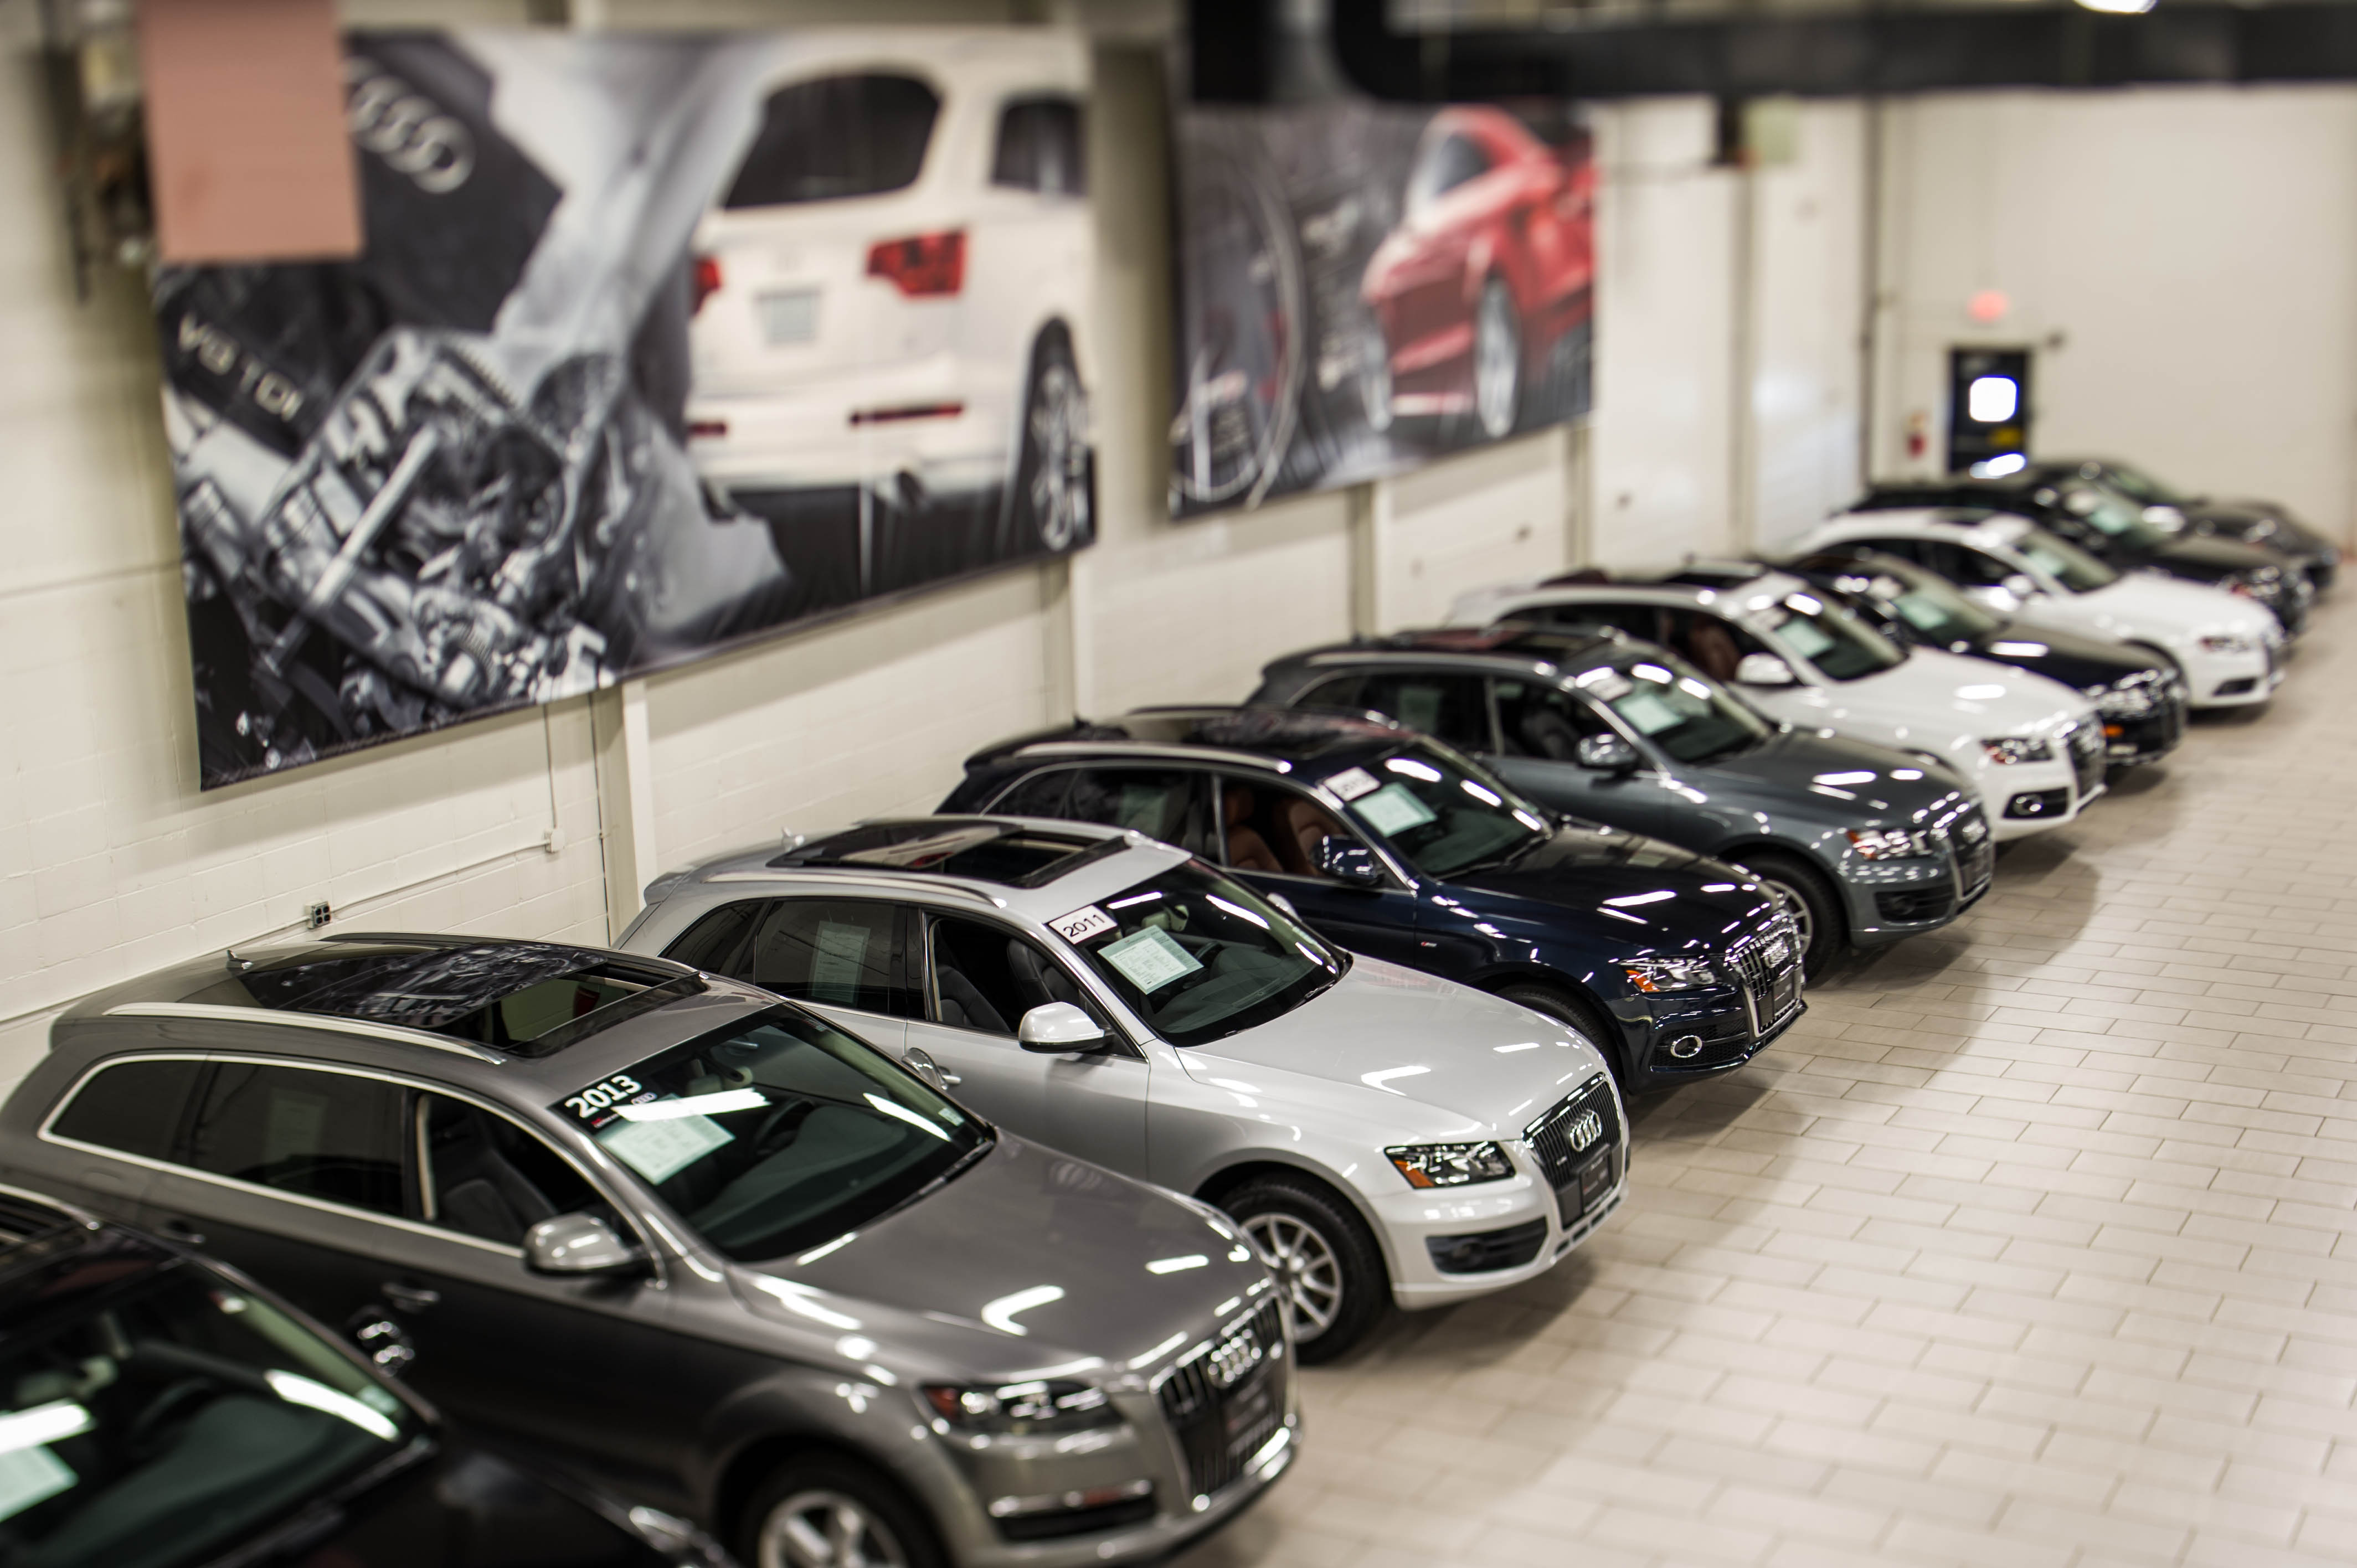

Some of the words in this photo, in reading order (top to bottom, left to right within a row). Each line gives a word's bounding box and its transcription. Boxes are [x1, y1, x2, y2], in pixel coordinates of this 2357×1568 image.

[239, 354, 303, 422] TDI
[1063, 914, 1105, 937] 2011
[564, 1075, 642, 1118] 2013
